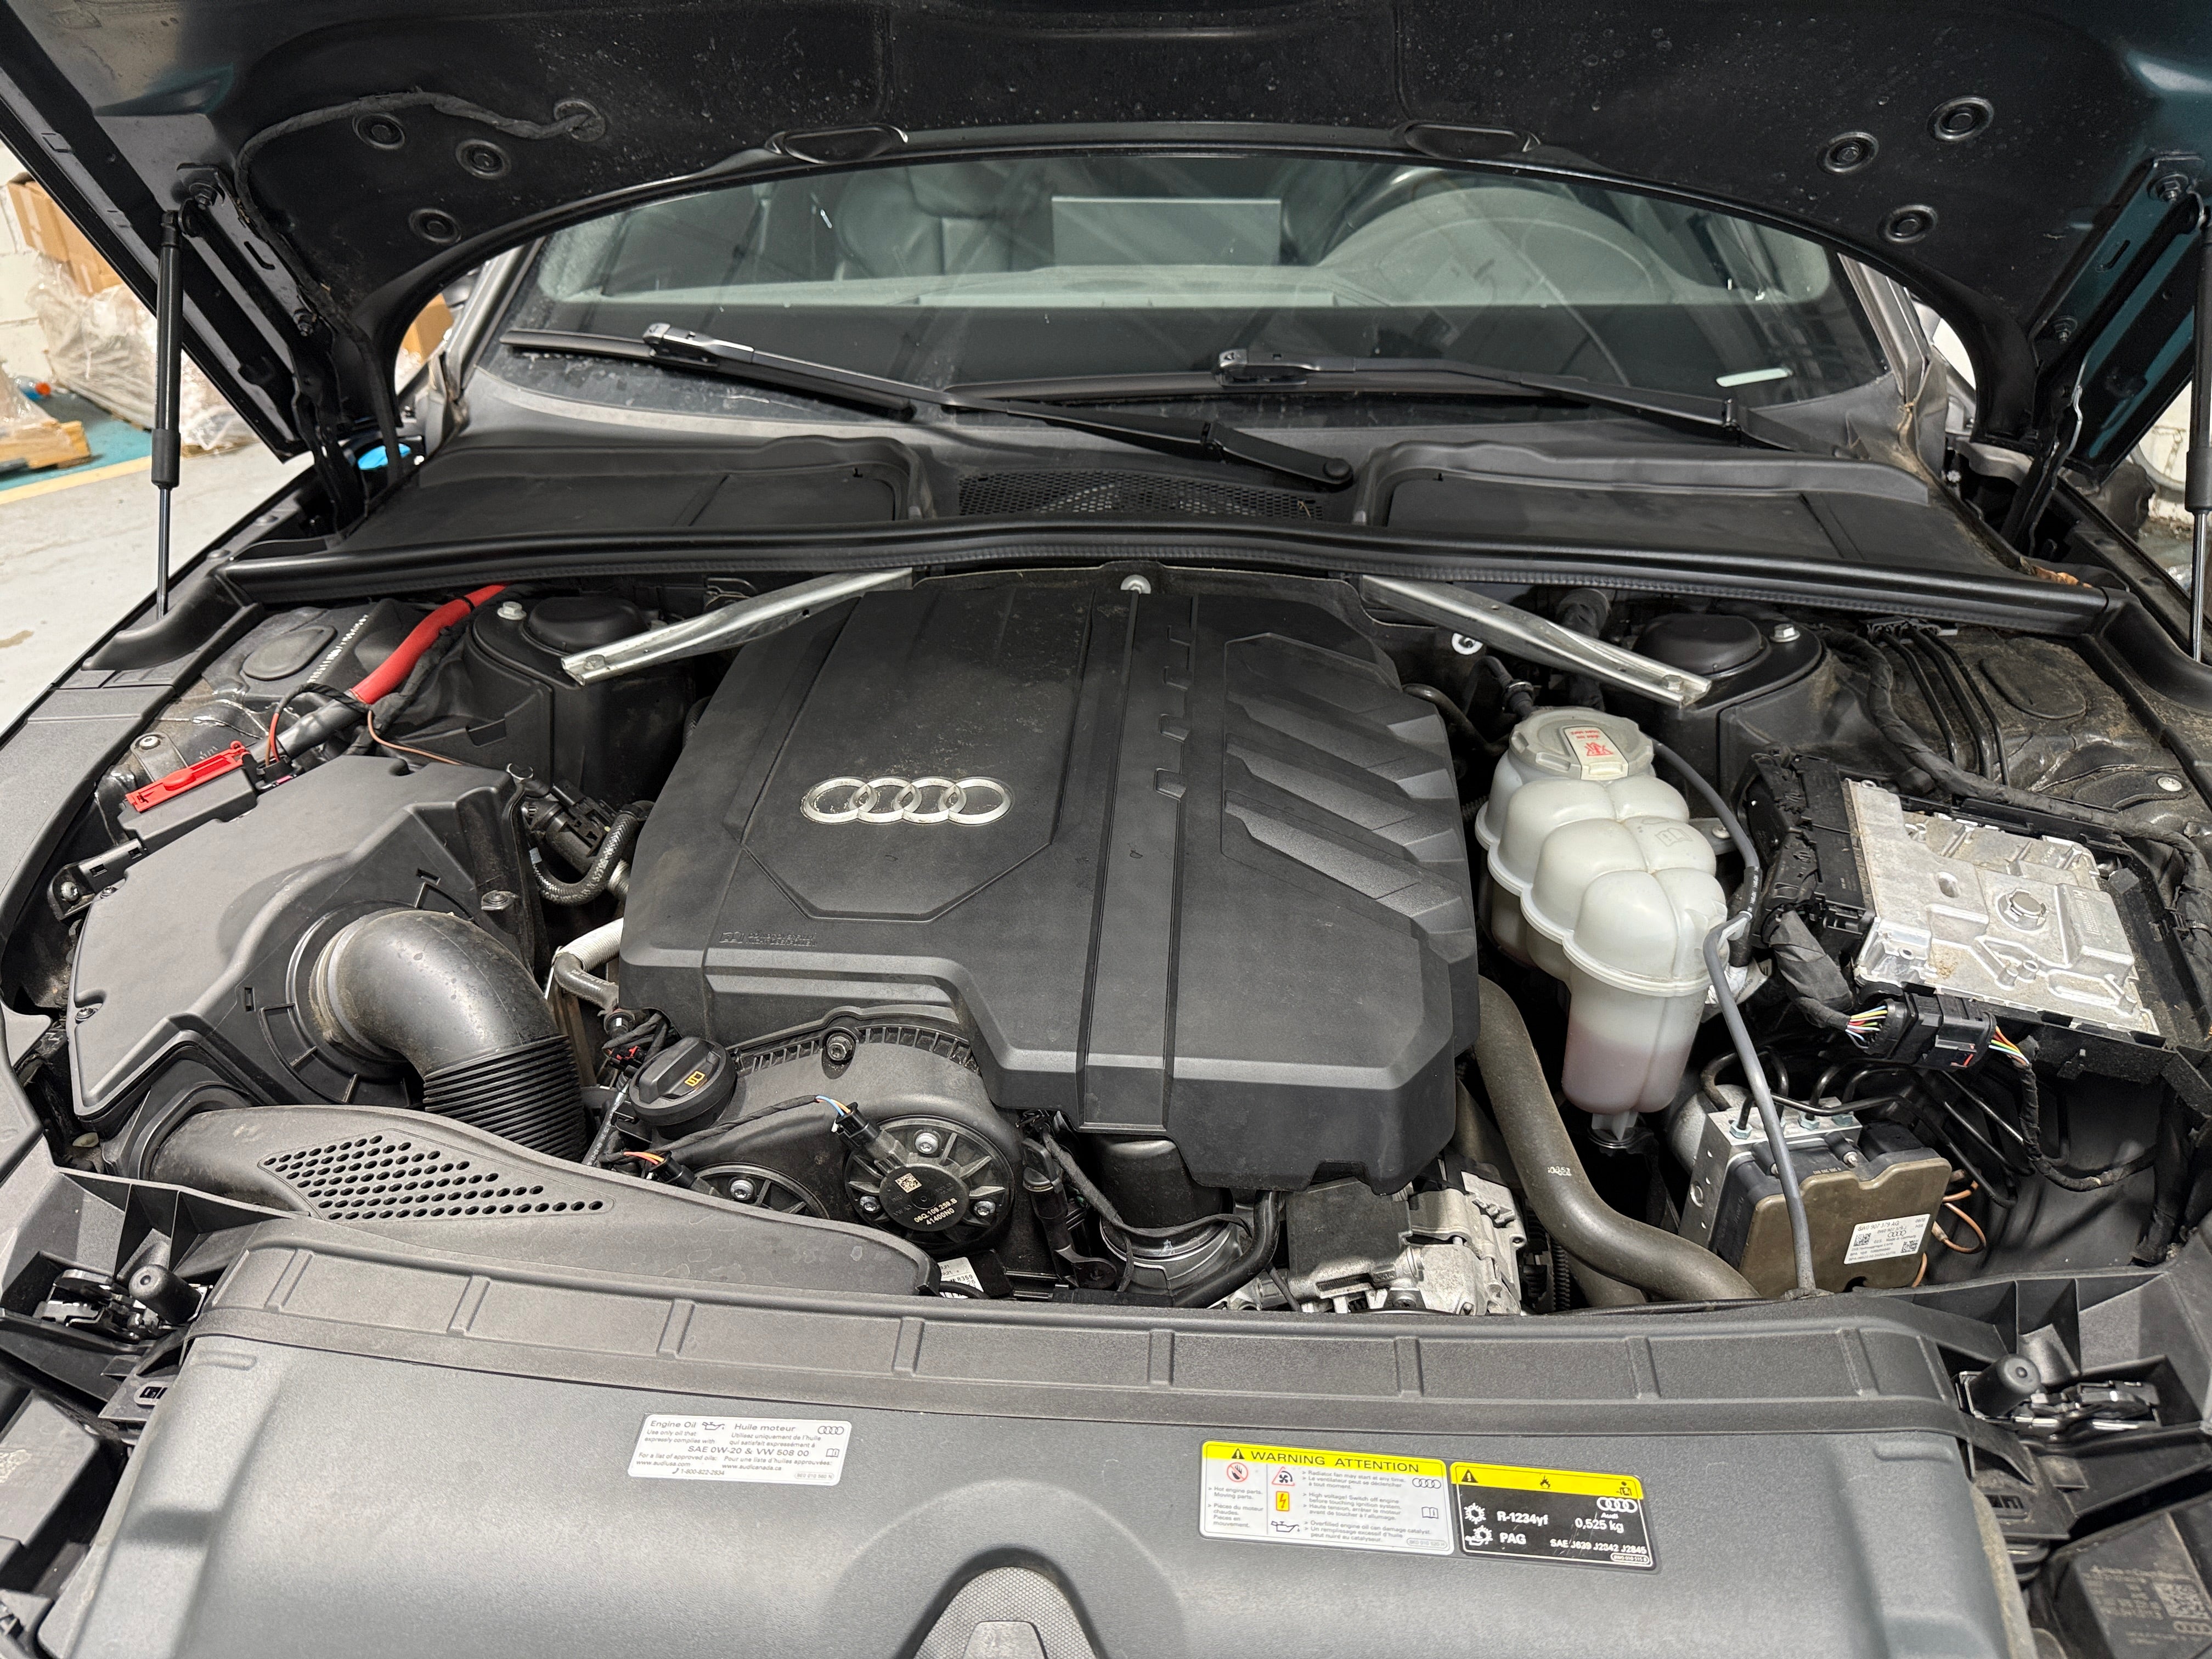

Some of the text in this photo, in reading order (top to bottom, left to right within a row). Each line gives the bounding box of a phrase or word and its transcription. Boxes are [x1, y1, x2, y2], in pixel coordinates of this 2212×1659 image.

[926, 1207, 955, 1225] 41400N0
[1251, 1451, 1419, 1472] WARNING ATTENTION
[1497, 1511, 1624, 1534] R-1234yf 0,525 kg
[1499, 1532, 1526, 1545] PAG
[1550, 1539, 1646, 1554] SAE J639 J2342 J2845
